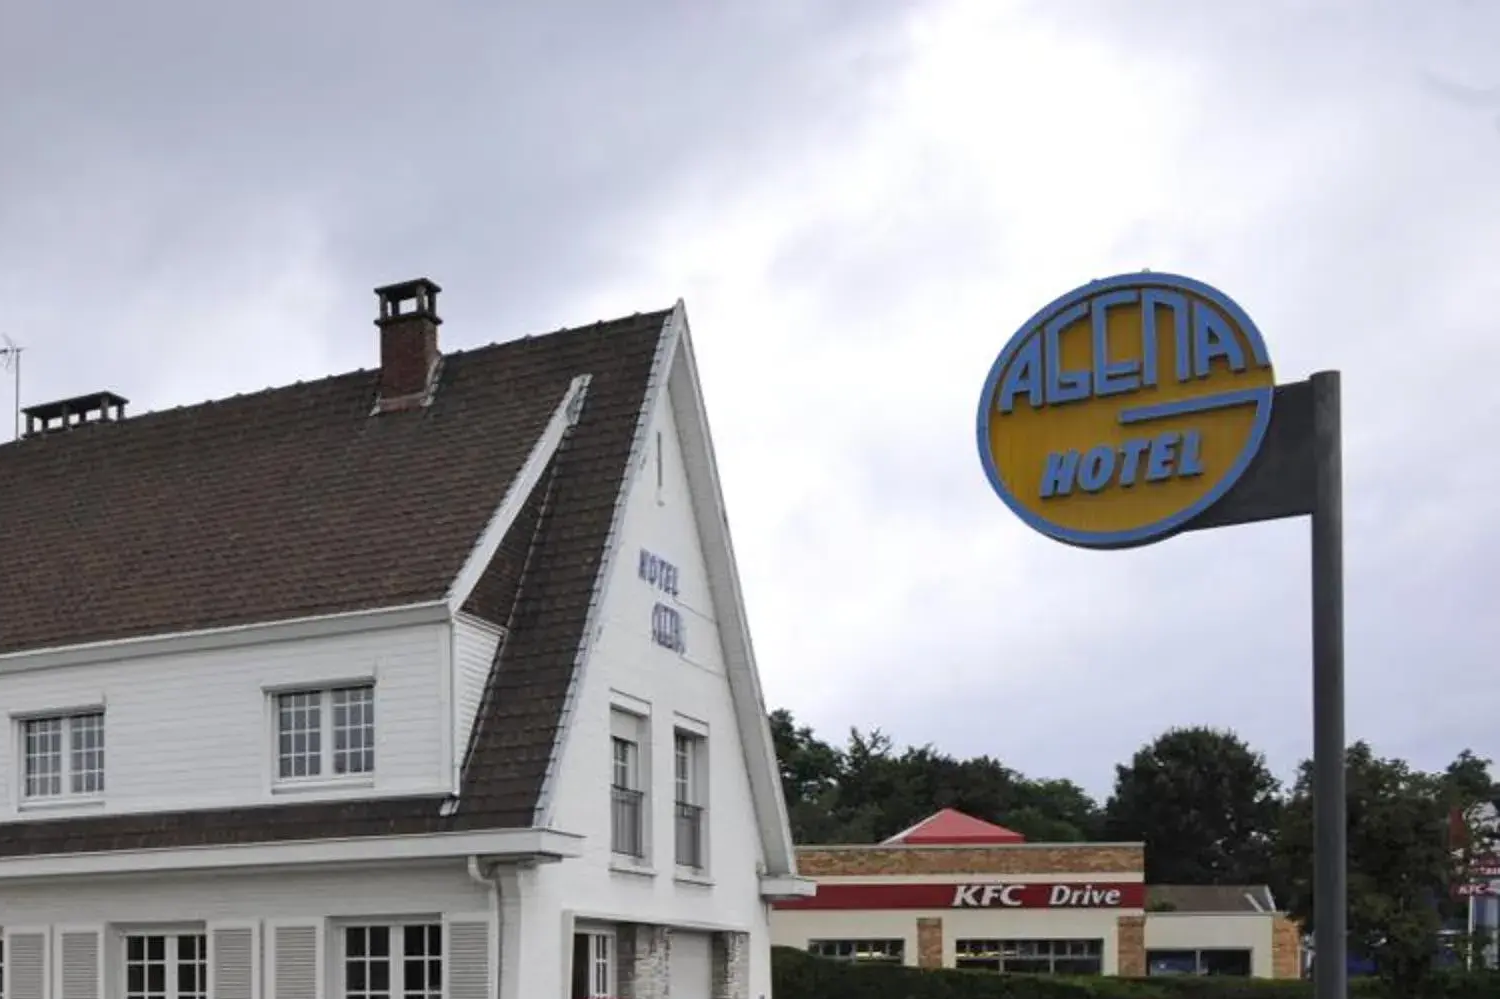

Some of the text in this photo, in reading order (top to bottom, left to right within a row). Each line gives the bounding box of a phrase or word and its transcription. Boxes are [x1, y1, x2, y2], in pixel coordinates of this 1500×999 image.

[997, 287, 1247, 415] AGENA
[1040, 430, 1206, 499] HOTEL
[638, 549, 680, 597] HOTEL
[952, 884, 1121, 907] KFC Drive
